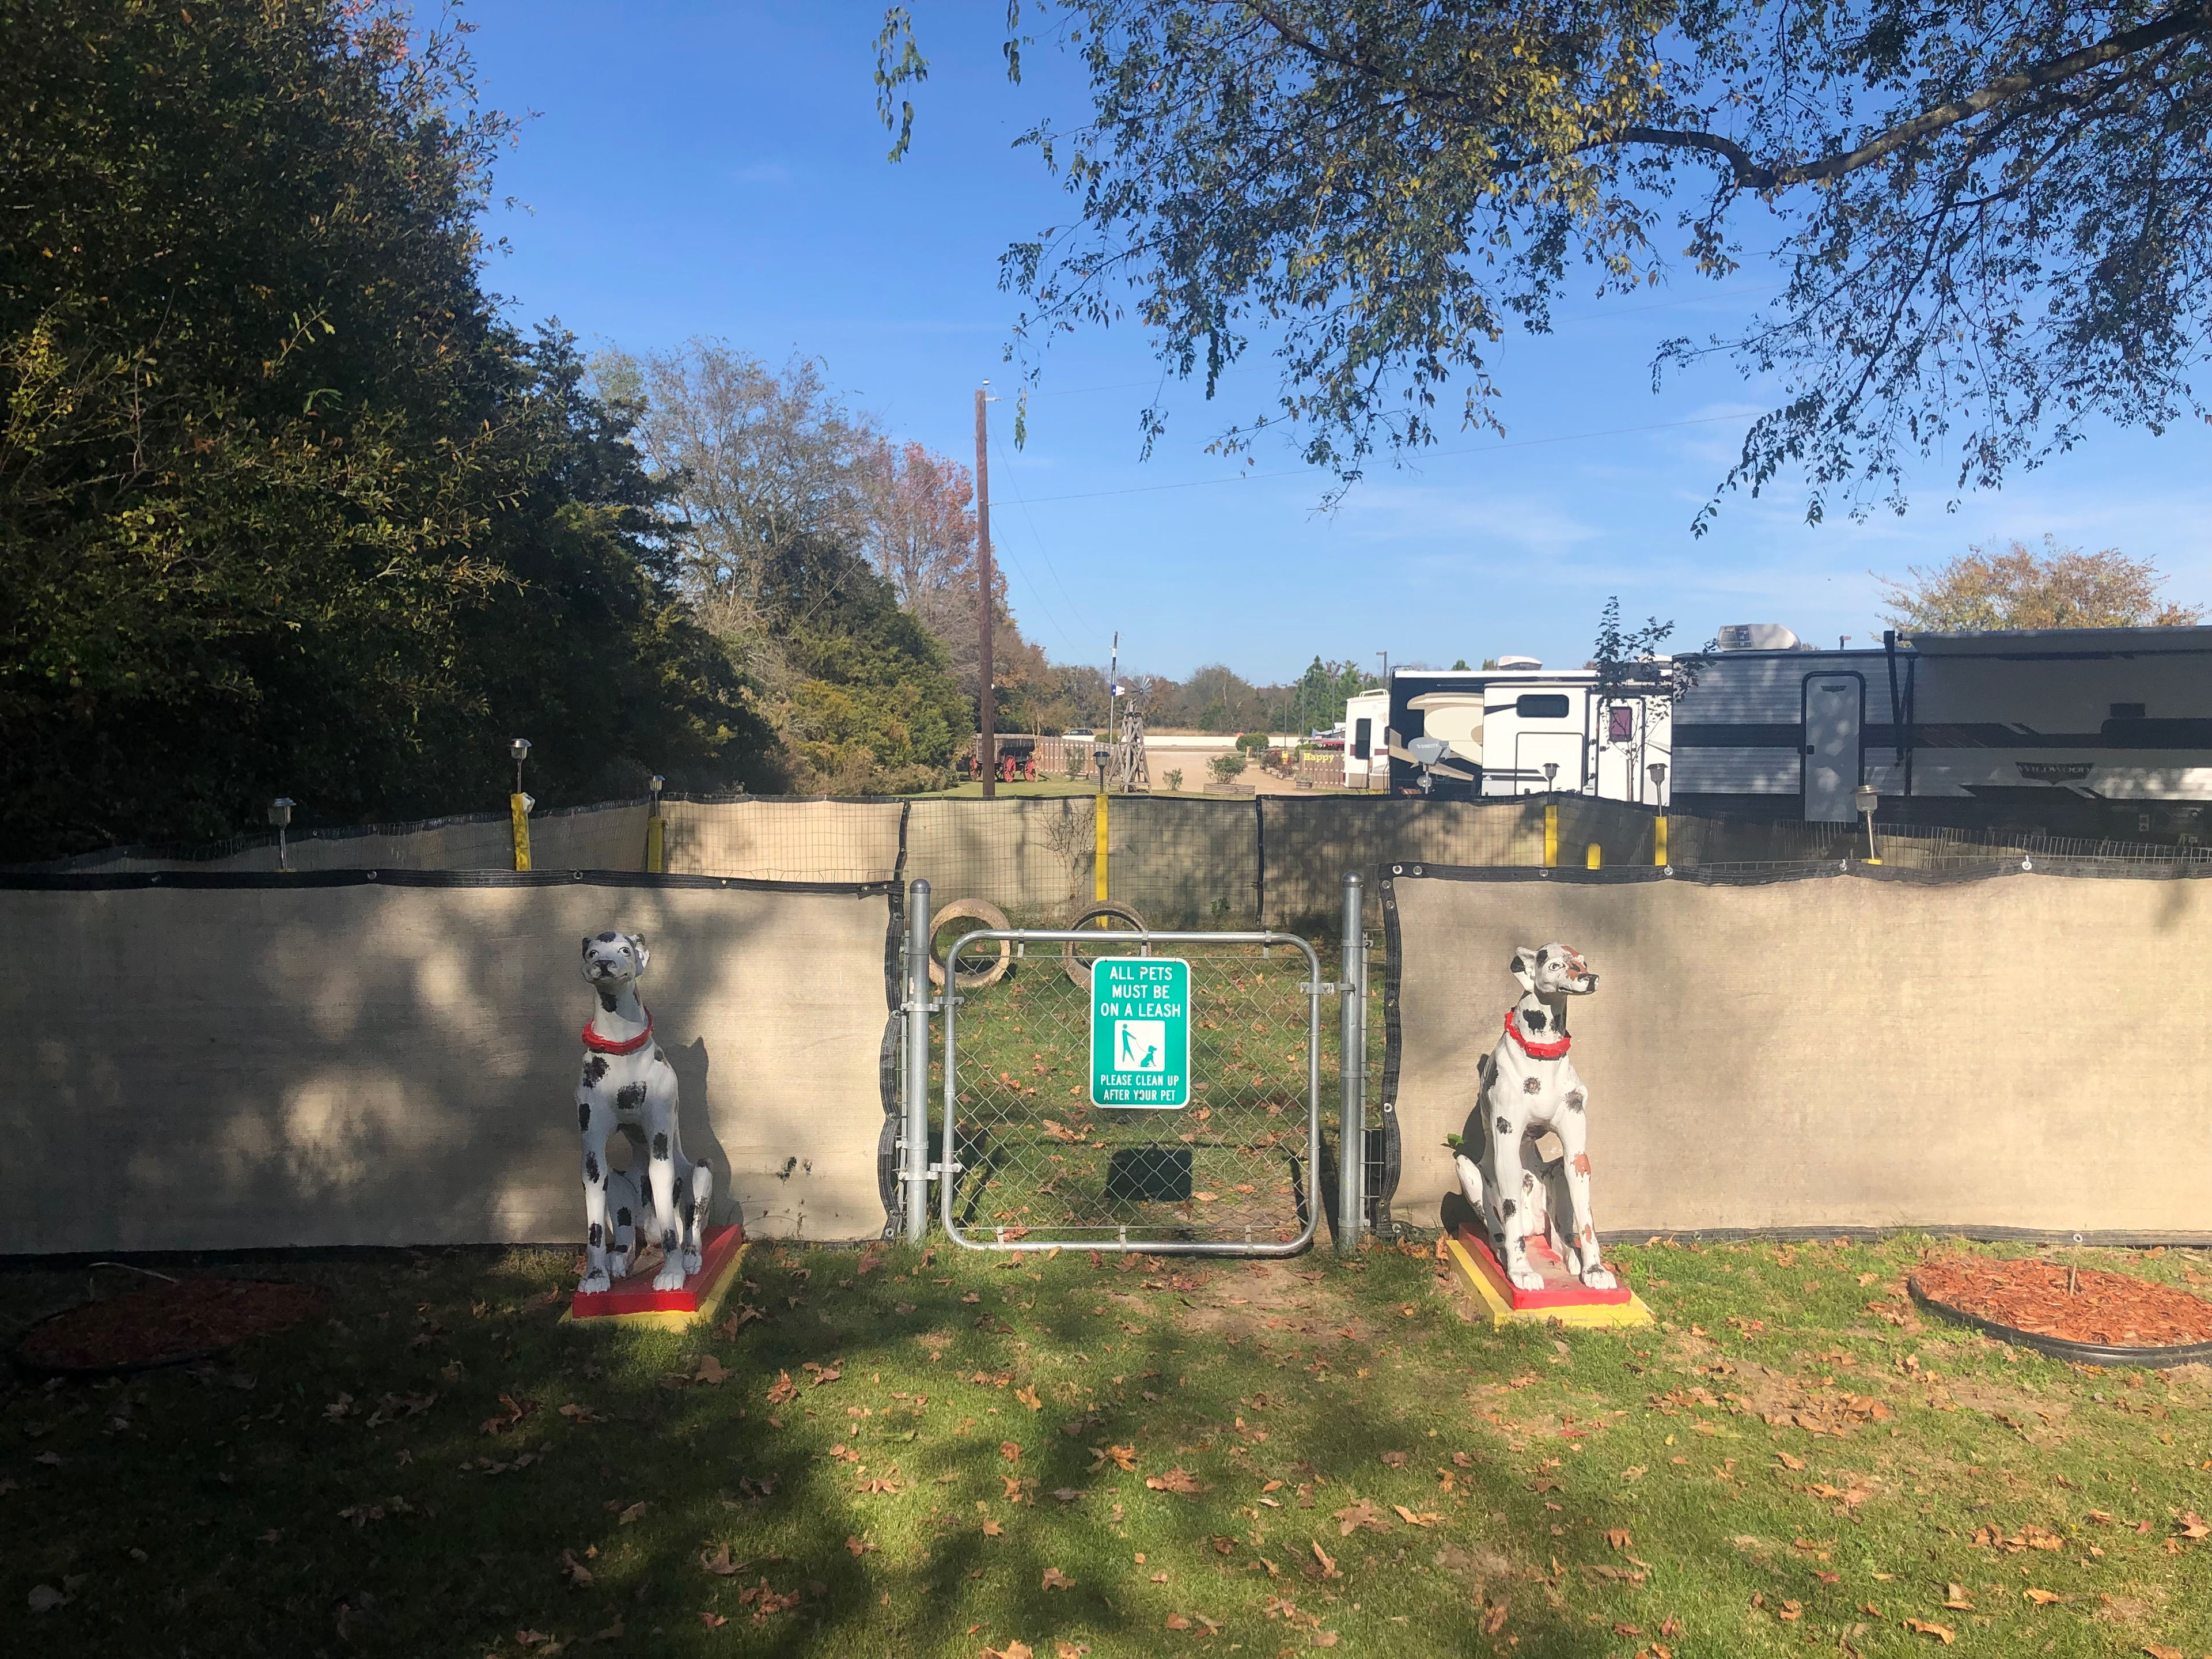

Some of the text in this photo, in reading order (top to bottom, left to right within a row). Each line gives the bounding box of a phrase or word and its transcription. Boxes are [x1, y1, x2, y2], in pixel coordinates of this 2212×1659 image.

[1304, 753, 1334, 763] Happy
[1109, 966, 1172, 980] ALL PETS
[1112, 984, 1170, 999] MUST BE
[1100, 1002, 1181, 1017] ON A LEASH
[1100, 1074, 1179, 1086] PLEASE CLEAN UP
[1103, 1089, 1176, 1101] AFTER YOUR PET
